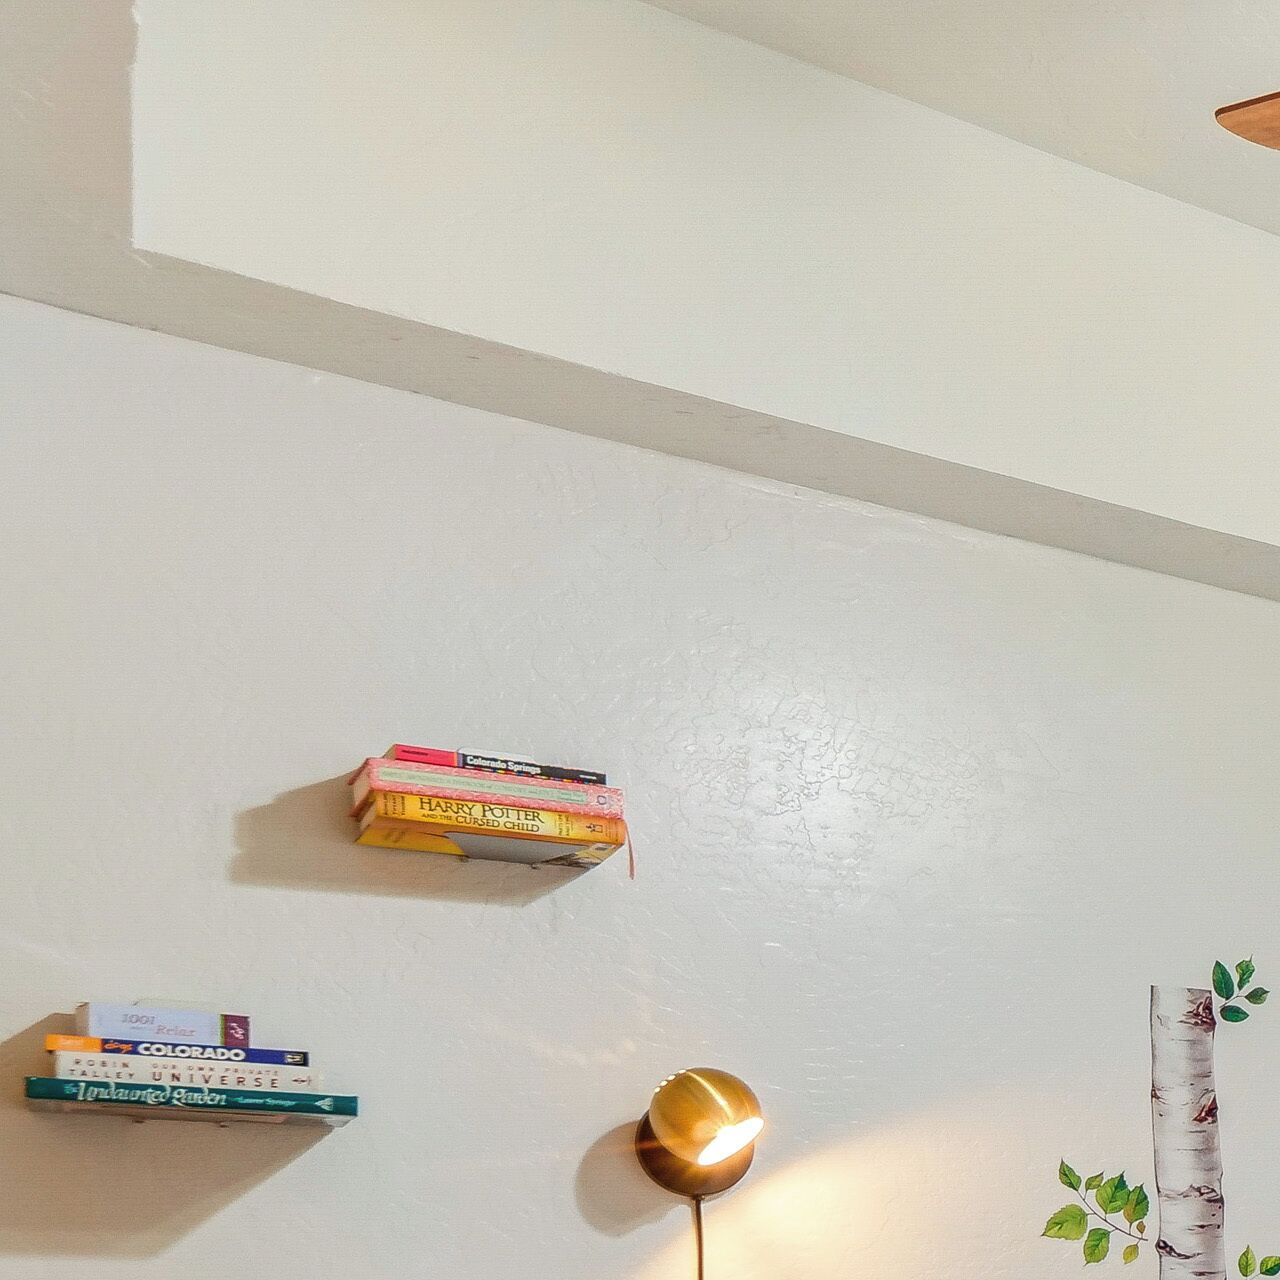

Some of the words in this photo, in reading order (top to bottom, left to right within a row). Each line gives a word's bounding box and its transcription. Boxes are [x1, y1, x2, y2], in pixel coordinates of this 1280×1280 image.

[466, 755, 507, 769] Colorado
[508, 761, 541, 774] Springs
[418, 797, 477, 817] HARRY
[482, 804, 544, 824] POTTER
[456, 815, 500, 828] CURSED
[504, 820, 540, 832] CHILD
[137, 1043, 246, 1060] COLORADO
[75, 1059, 129, 1068] ROBIN
[69, 1069, 135, 1079] TALLEY
[152, 1071, 279, 1088] UNIVERSE
